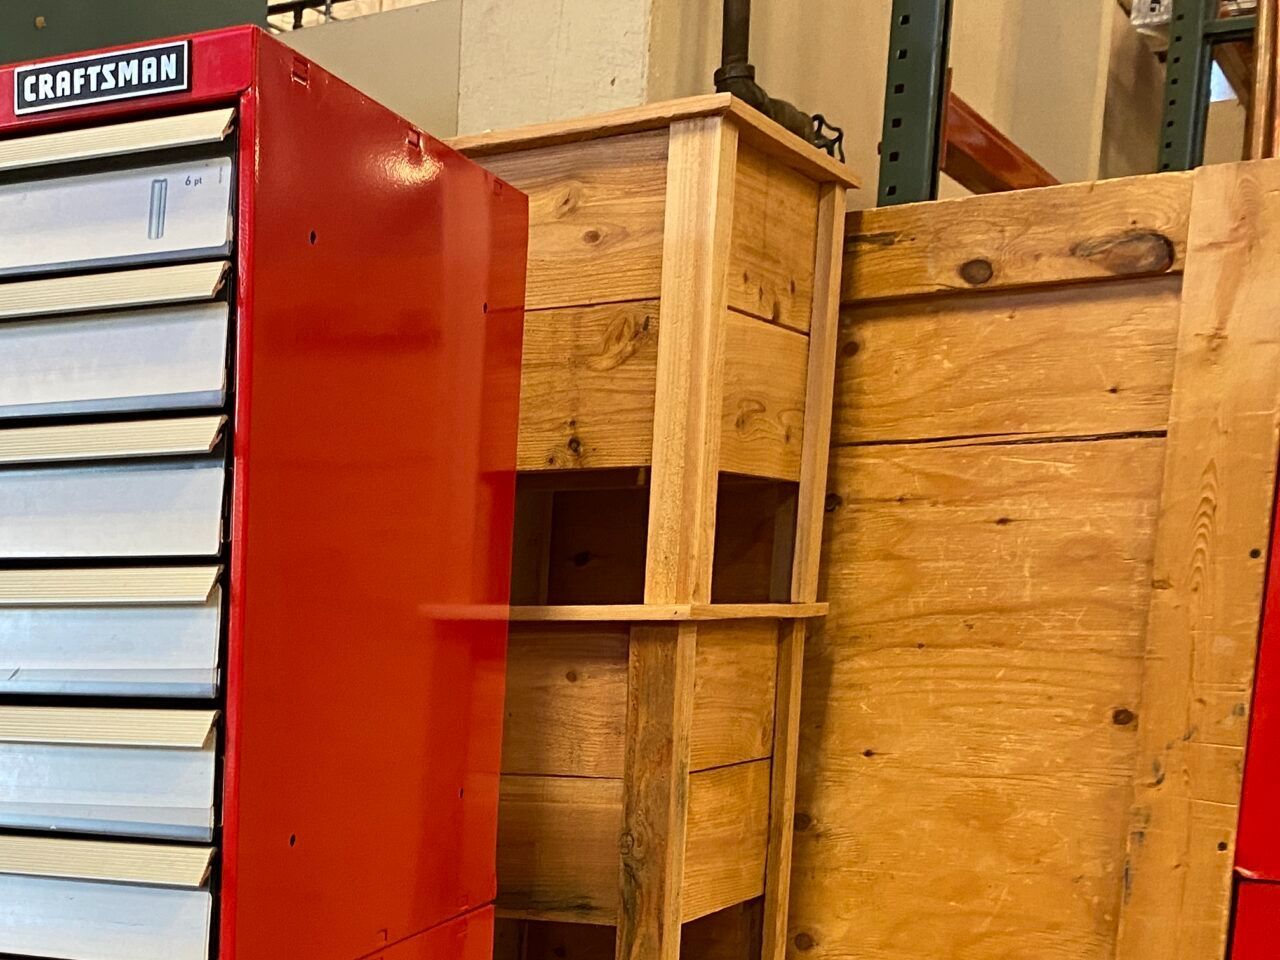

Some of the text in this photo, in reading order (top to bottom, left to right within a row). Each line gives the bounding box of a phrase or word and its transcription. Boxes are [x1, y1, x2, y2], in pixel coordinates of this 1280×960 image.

[23, 53, 177, 102] CRAFTSMAN
[185, 175, 202, 187] 6 pt
